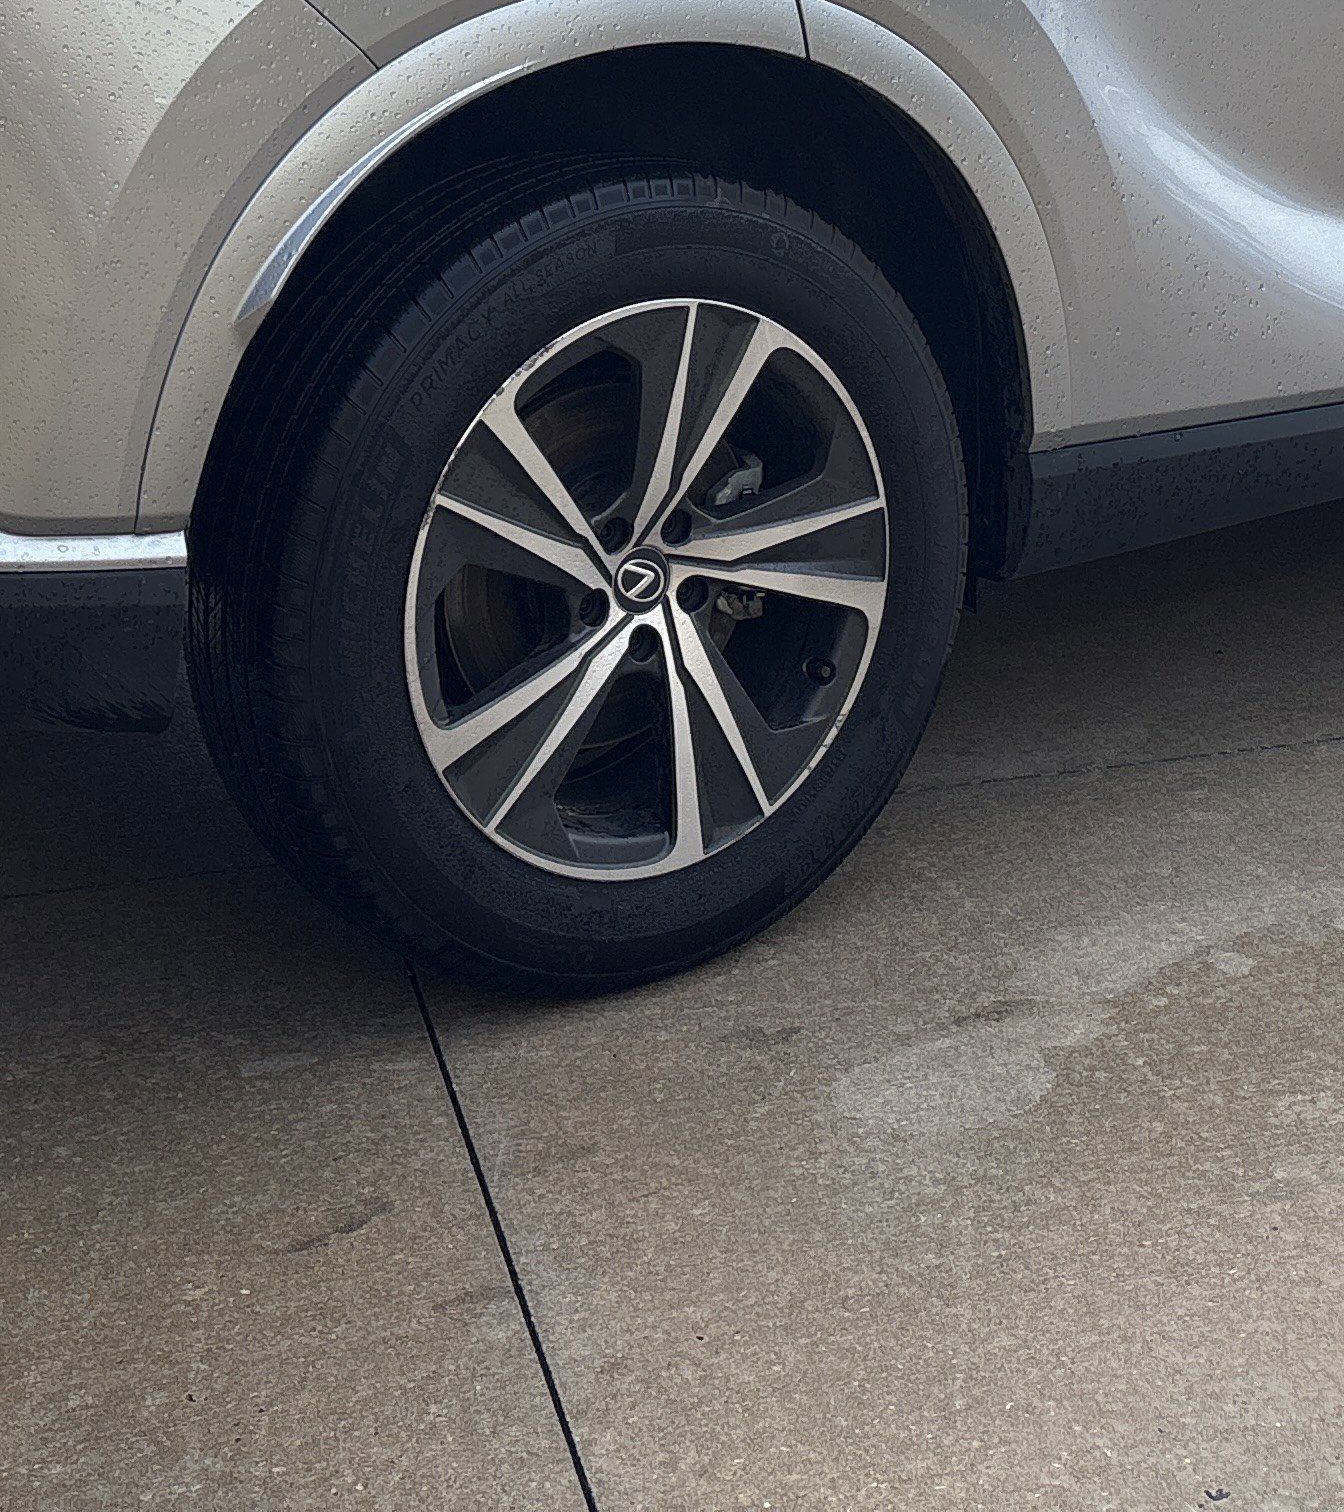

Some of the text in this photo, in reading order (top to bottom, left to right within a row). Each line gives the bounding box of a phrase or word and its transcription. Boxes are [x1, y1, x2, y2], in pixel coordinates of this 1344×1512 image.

[410, 242, 598, 412] PRIMACY ALL SEASON
